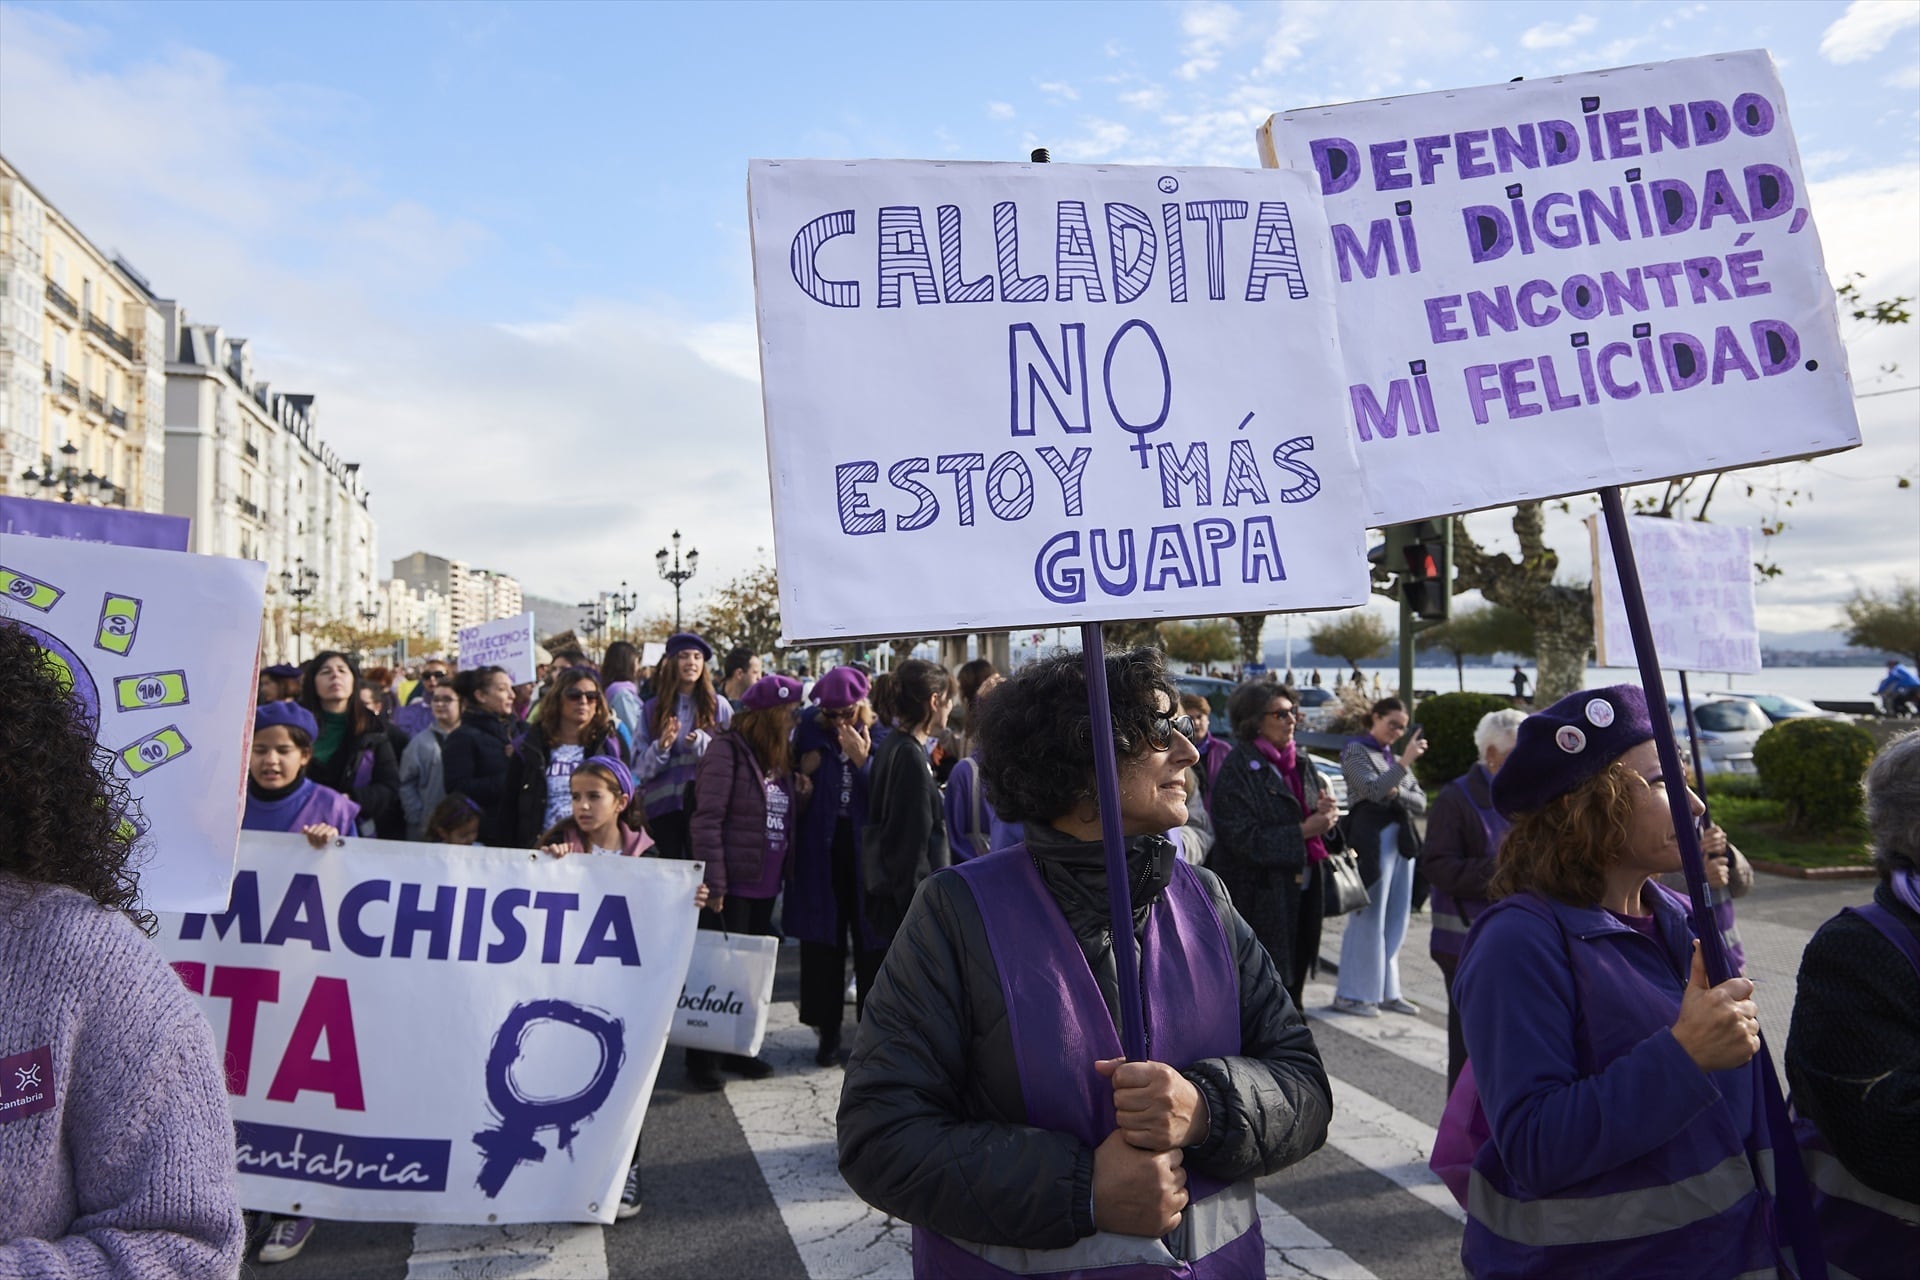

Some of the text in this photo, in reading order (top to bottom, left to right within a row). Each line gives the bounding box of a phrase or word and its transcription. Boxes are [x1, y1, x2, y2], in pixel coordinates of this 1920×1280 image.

[1309, 91, 1775, 196] DEFENDIENDO
[790, 176, 1309, 308] CALLADITA
[1331, 162, 1809, 283] MI DIGNIDAD,
[1424, 232, 1772, 344] ENCONTRÉ
[1009, 319, 1171, 468] NO
[1349, 319, 1819, 443] MI FELICIDAD.
[836, 412, 1321, 535] ESTOY MÁS
[10, 581, 33, 597] 50
[1034, 515, 1287, 604] GUAPA
[109, 616, 127, 634] 20
[460, 627, 480, 641] NO
[141, 744, 163, 760] 10
[179, 870, 642, 966] MACHISTA
[169, 961, 366, 1112] TA
